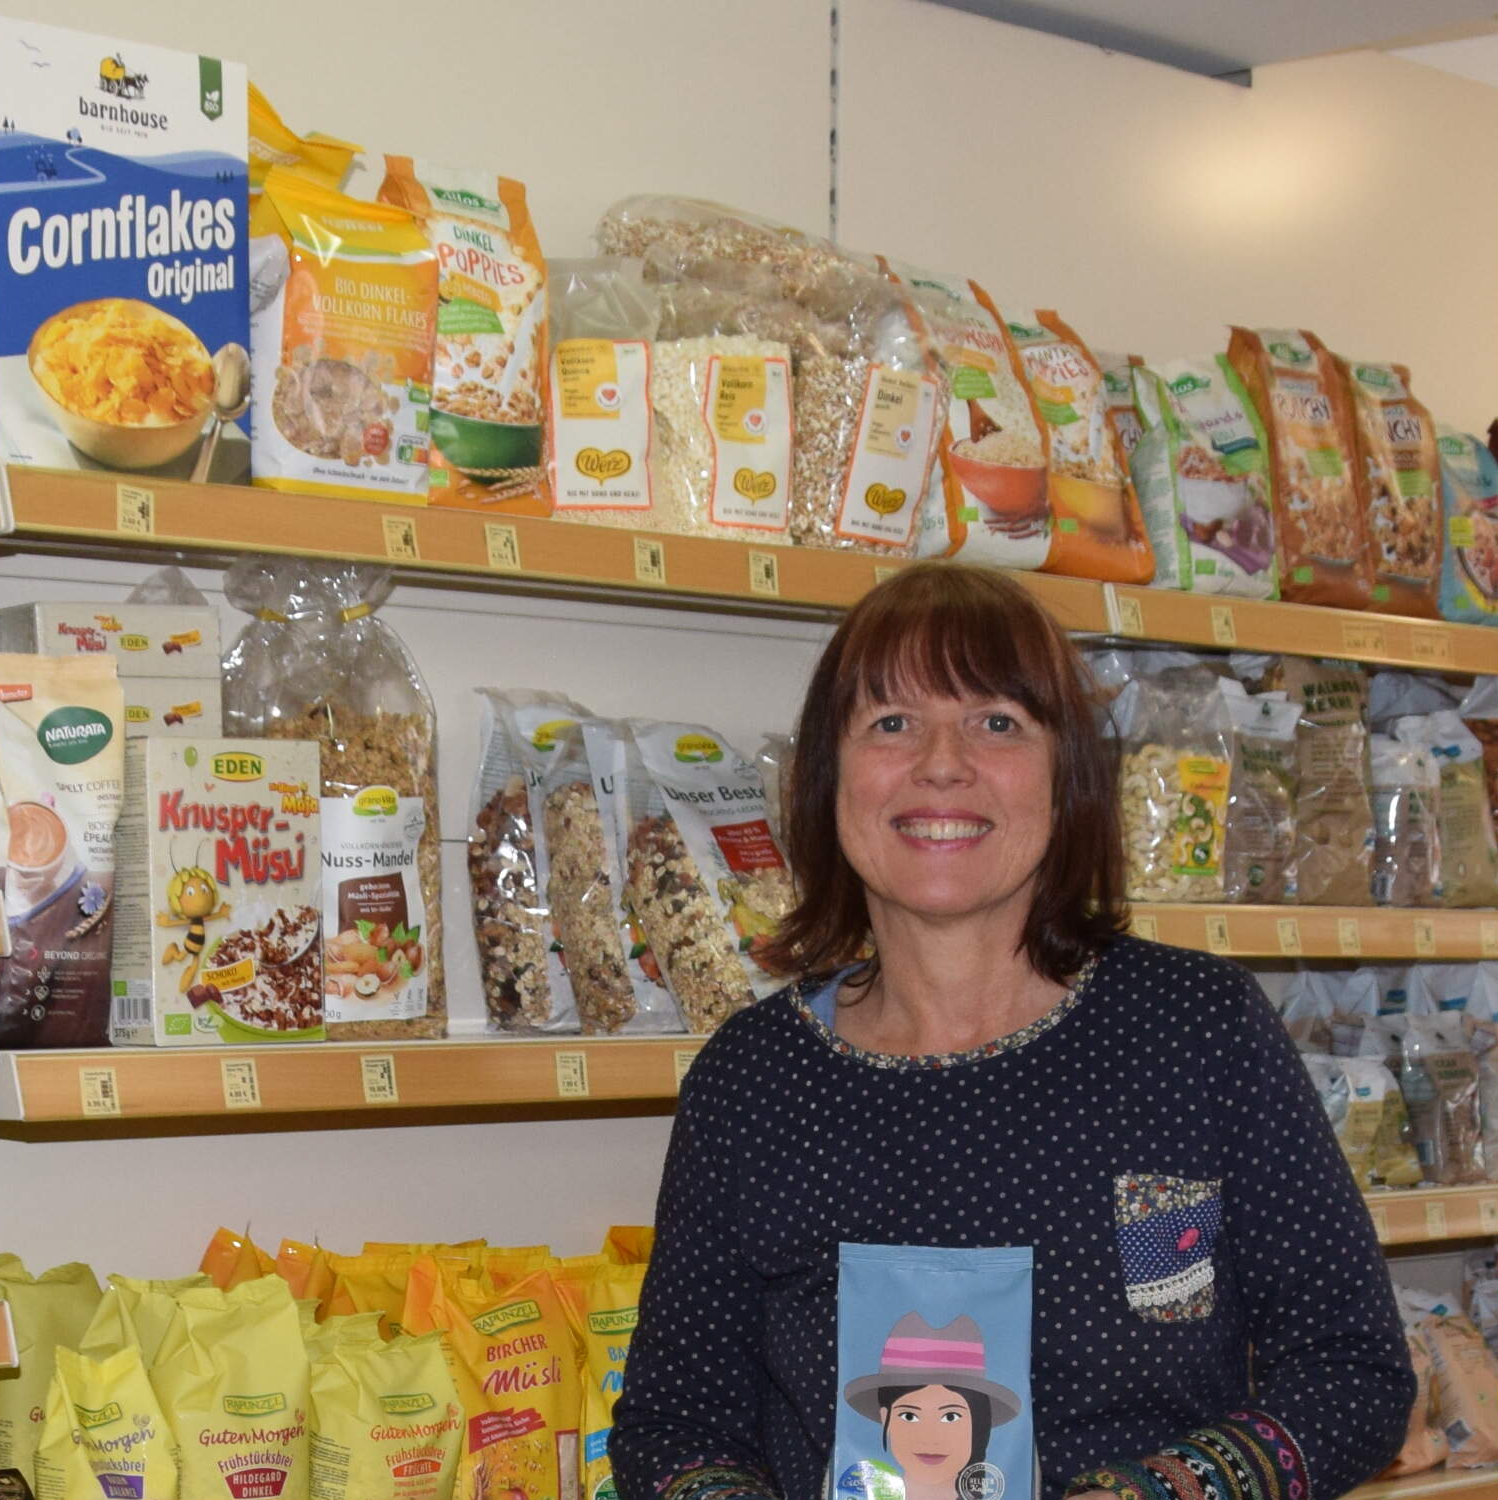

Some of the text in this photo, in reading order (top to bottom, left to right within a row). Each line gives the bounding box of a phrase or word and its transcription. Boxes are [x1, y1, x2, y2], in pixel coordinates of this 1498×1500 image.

[79, 97, 167, 130] barnhouse
[8, 189, 235, 274] Cornflakes
[148, 256, 233, 304] Original
[335, 278, 410, 302] BIO DINKEL-
[312, 295, 382, 320] VOLLKORN
[386, 307, 426, 328] FLAKES
[585, 451, 621, 475] Werz
[214, 758, 262, 775] EDEN
[159, 790, 289, 838] Knusper-
[321, 850, 414, 872] Nuss-Mandel
[474, 1307, 537, 1334] RAPUNZEL
[486, 1334, 547, 1359] BIRCHER
[483, 1361, 560, 1393] Müsli
[200, 1425, 305, 1446] Guten Morgen
[218, 1454, 293, 1473] Frühstücksbrei
[232, 1472, 281, 1484] HILDEGARD
[242, 1487, 273, 1497] DINKEL
